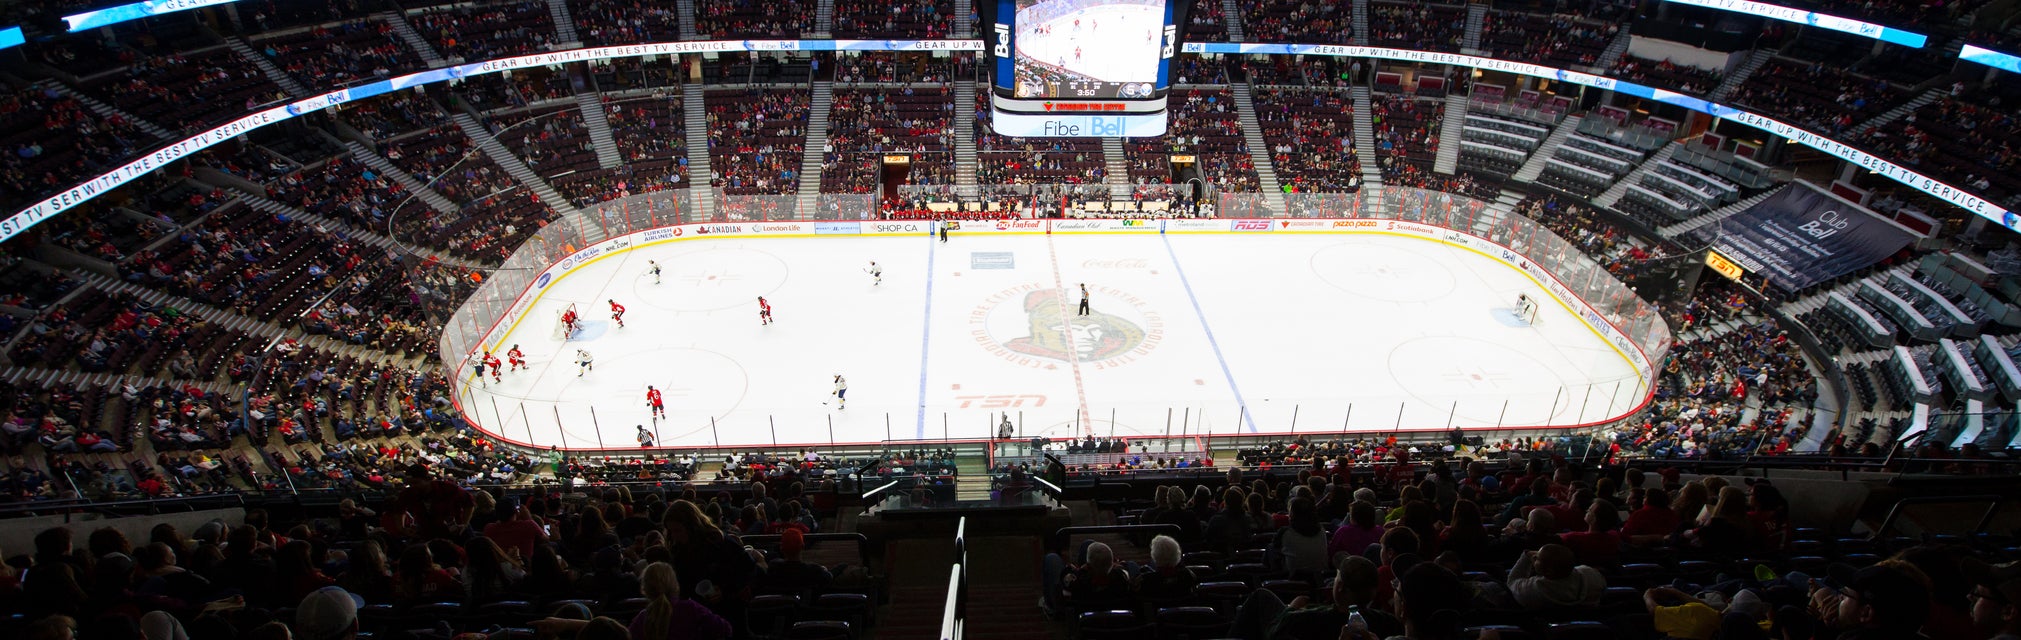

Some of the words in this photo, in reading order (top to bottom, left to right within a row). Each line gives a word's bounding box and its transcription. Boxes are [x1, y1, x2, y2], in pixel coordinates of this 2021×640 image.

[780, 41, 795, 50] Bell
[915, 41, 947, 49] GEAR
[994, 23, 1009, 58] Bell
[1163, 24, 1176, 59] Bell
[1187, 43, 1201, 52] Bell
[483, 58, 517, 71] GEAR
[525, 55, 541, 65] UP
[547, 50, 581, 63] WITH
[587, 47, 610, 58] THE
[617, 44, 648, 55] BEST
[654, 44, 668, 52] TV
[1314, 45, 1344, 55] GEAR
[1350, 47, 1364, 55] UP
[1370, 48, 1399, 58] WITH
[1404, 51, 1425, 60] THE
[1432, 53, 1461, 63] BEST
[1467, 56, 1481, 66] TV
[1595, 76, 1611, 87] Bell
[1127, 86, 1135, 95] 5
[327, 92, 346, 106] Bell
[1044, 120, 1080, 136] Fibe
[1091, 116, 1126, 136] Bell
[1737, 112, 1772, 129] GEAR
[1777, 123, 1794, 135] UP
[1797, 131, 1831, 151] WITH
[1833, 143, 1857, 161] THE
[1862, 154, 1896, 175] BEST
[1899, 169, 1917, 184] TV
[1922, 179, 1989, 216] SERVICE.
[24, 205, 43, 222] TV
[125, 158, 151, 178] THE
[156, 141, 188, 164] BEST
[193, 134, 209, 149] TV
[1819, 210, 1850, 230] Club
[644, 228, 672, 237] TURKISH
[707, 225, 742, 234] CANADIAN
[877, 224, 901, 232] SHOP
[1397, 223, 1434, 235] Scotiabank
[1797, 219, 1839, 240] Bell
[644, 233, 673, 242] AIRLINES
[605, 241, 629, 252] NHL.COM
[1502, 249, 1516, 263] Bell
[1710, 255, 1737, 275] TSN
[955, 394, 1047, 408] TSN
